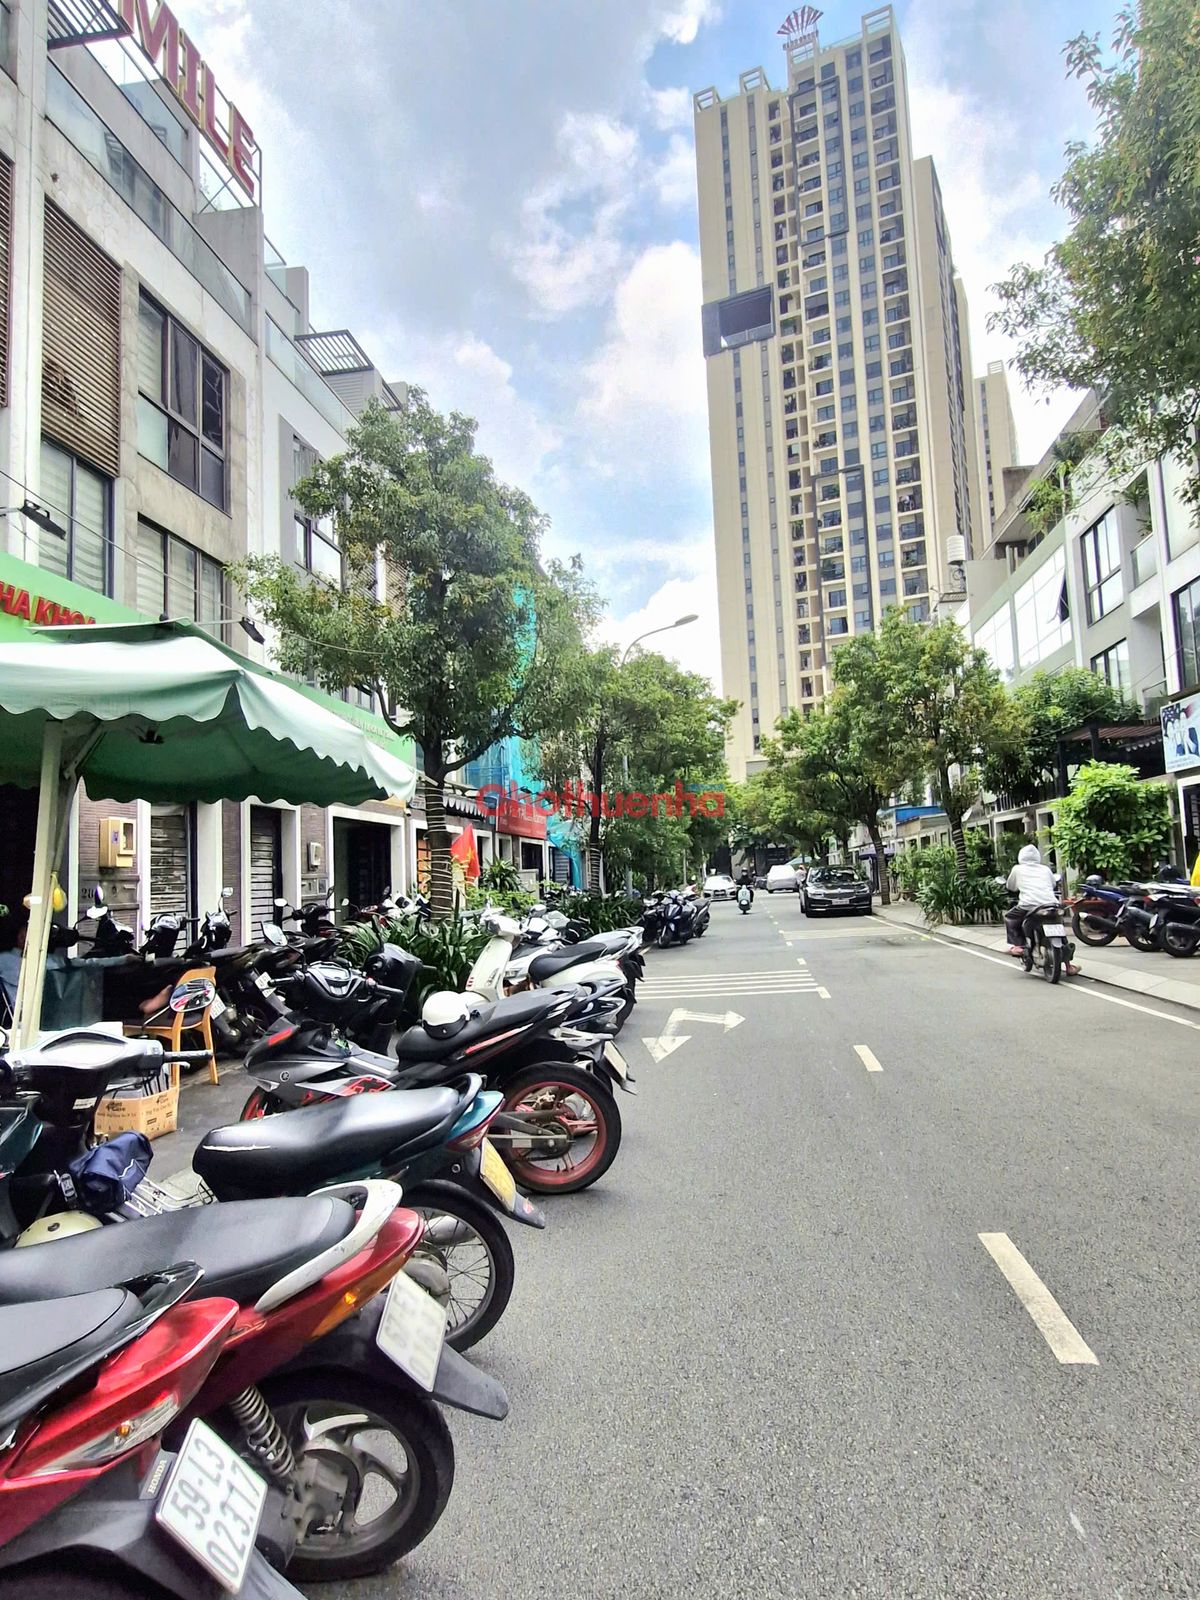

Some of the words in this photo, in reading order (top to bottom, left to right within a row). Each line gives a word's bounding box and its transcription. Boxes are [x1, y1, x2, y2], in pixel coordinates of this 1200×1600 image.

[35, 596, 96, 625] KHO
[147, 1459, 168, 1495] HONDA
[206, 1460, 260, 1579] 023.17
